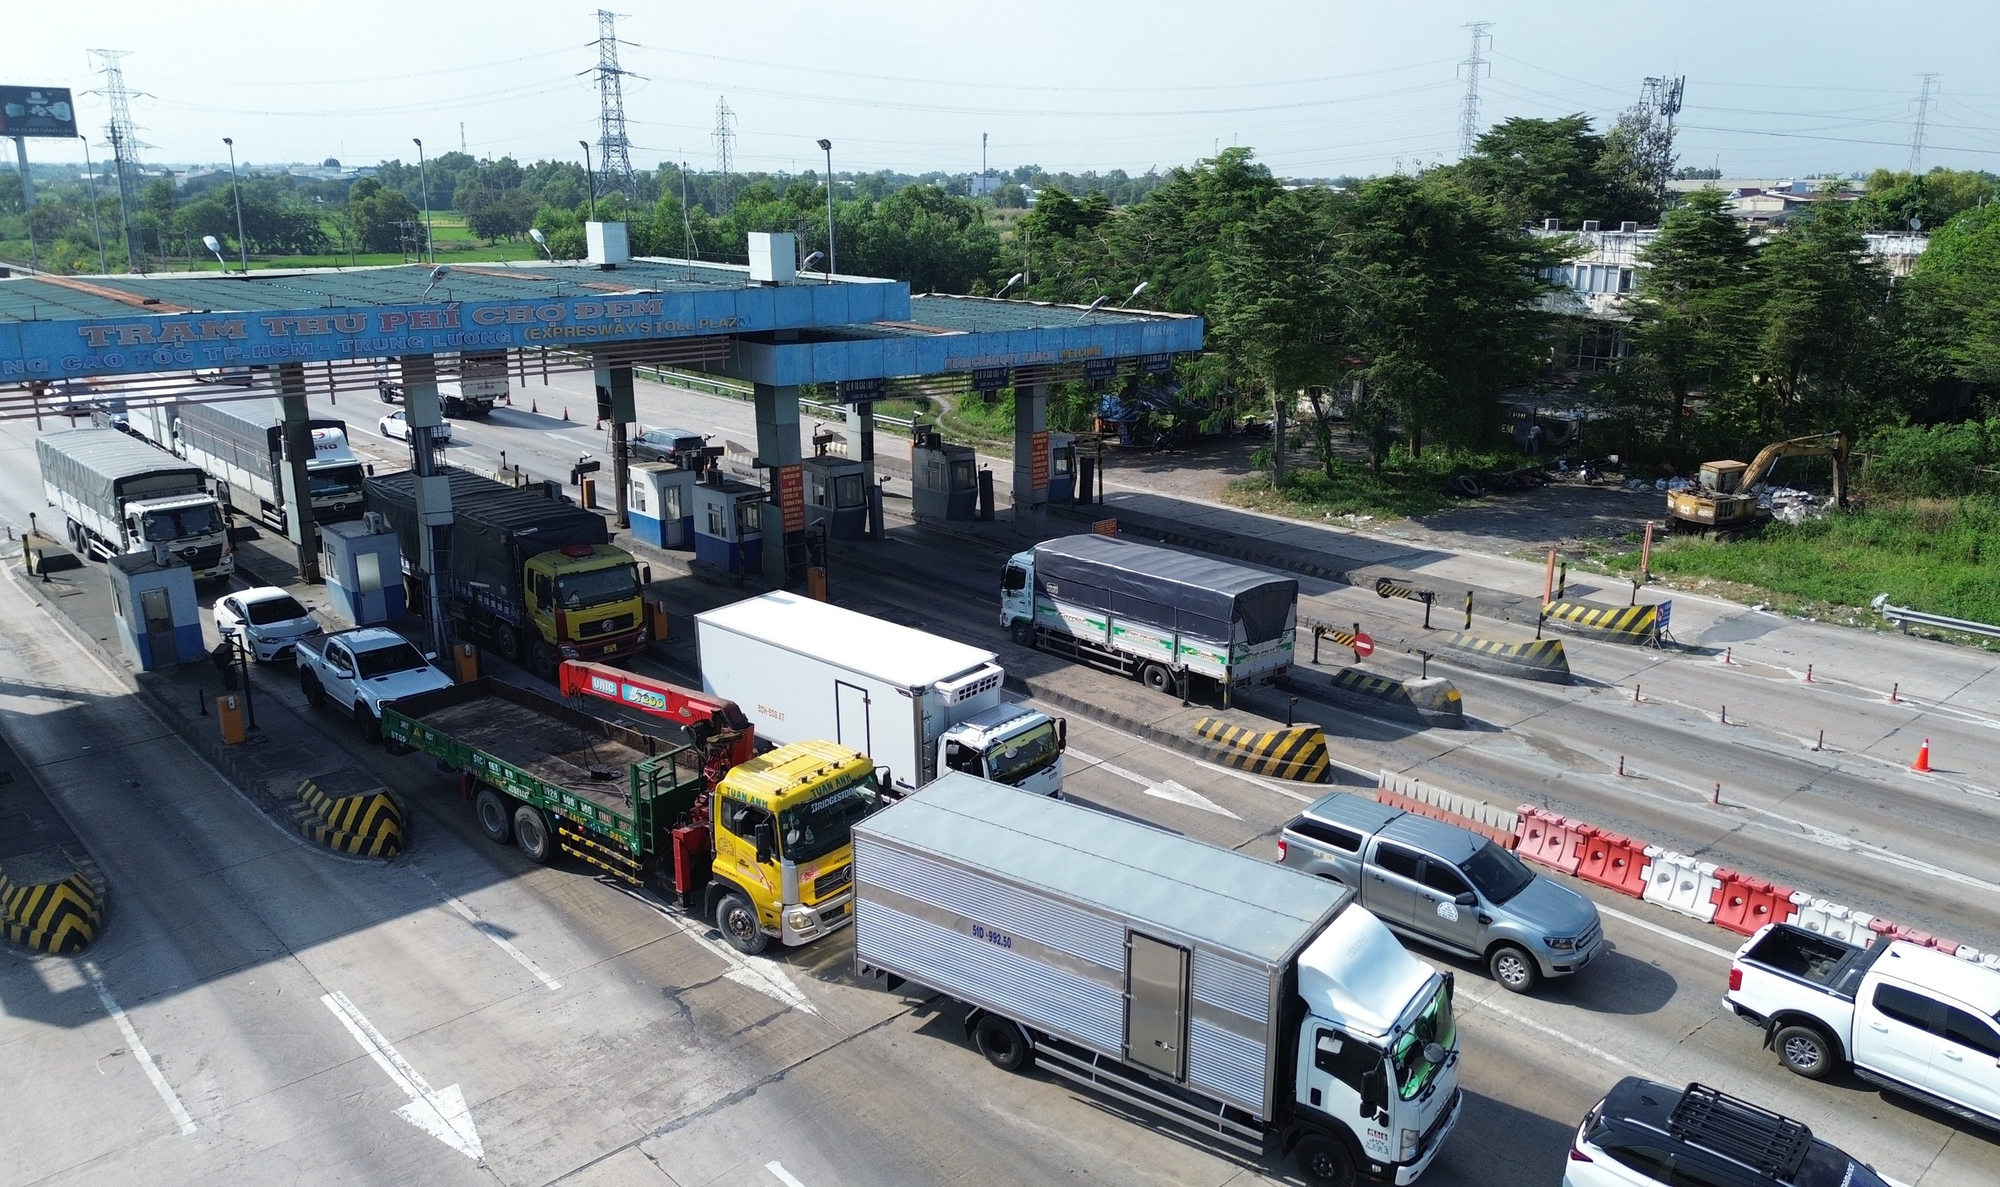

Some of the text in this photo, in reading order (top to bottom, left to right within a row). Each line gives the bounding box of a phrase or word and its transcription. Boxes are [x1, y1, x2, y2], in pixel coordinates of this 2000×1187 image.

[78, 319, 248, 348] TRẠM
[261, 313, 367, 337] THU
[378, 302, 460, 332] PHÍ
[472, 302, 567, 327] CHỢ
[654, 320, 694, 334] TOLL
[61, 353, 125, 371] CAO
[132, 343, 194, 364] TỐC
[203, 342, 313, 361] TP.HCM
[338, 336, 424, 353] TRUNG
[433, 331, 511, 347] LƯƠNG
[1059, 346, 1103, 359] WELCOME
[593, 678, 616, 694] UNIC
[390, 731, 407, 743] STOP
[835, 773, 853, 789] ANH
[750, 796, 768, 809] ANH
[972, 924, 985, 939] 51D
